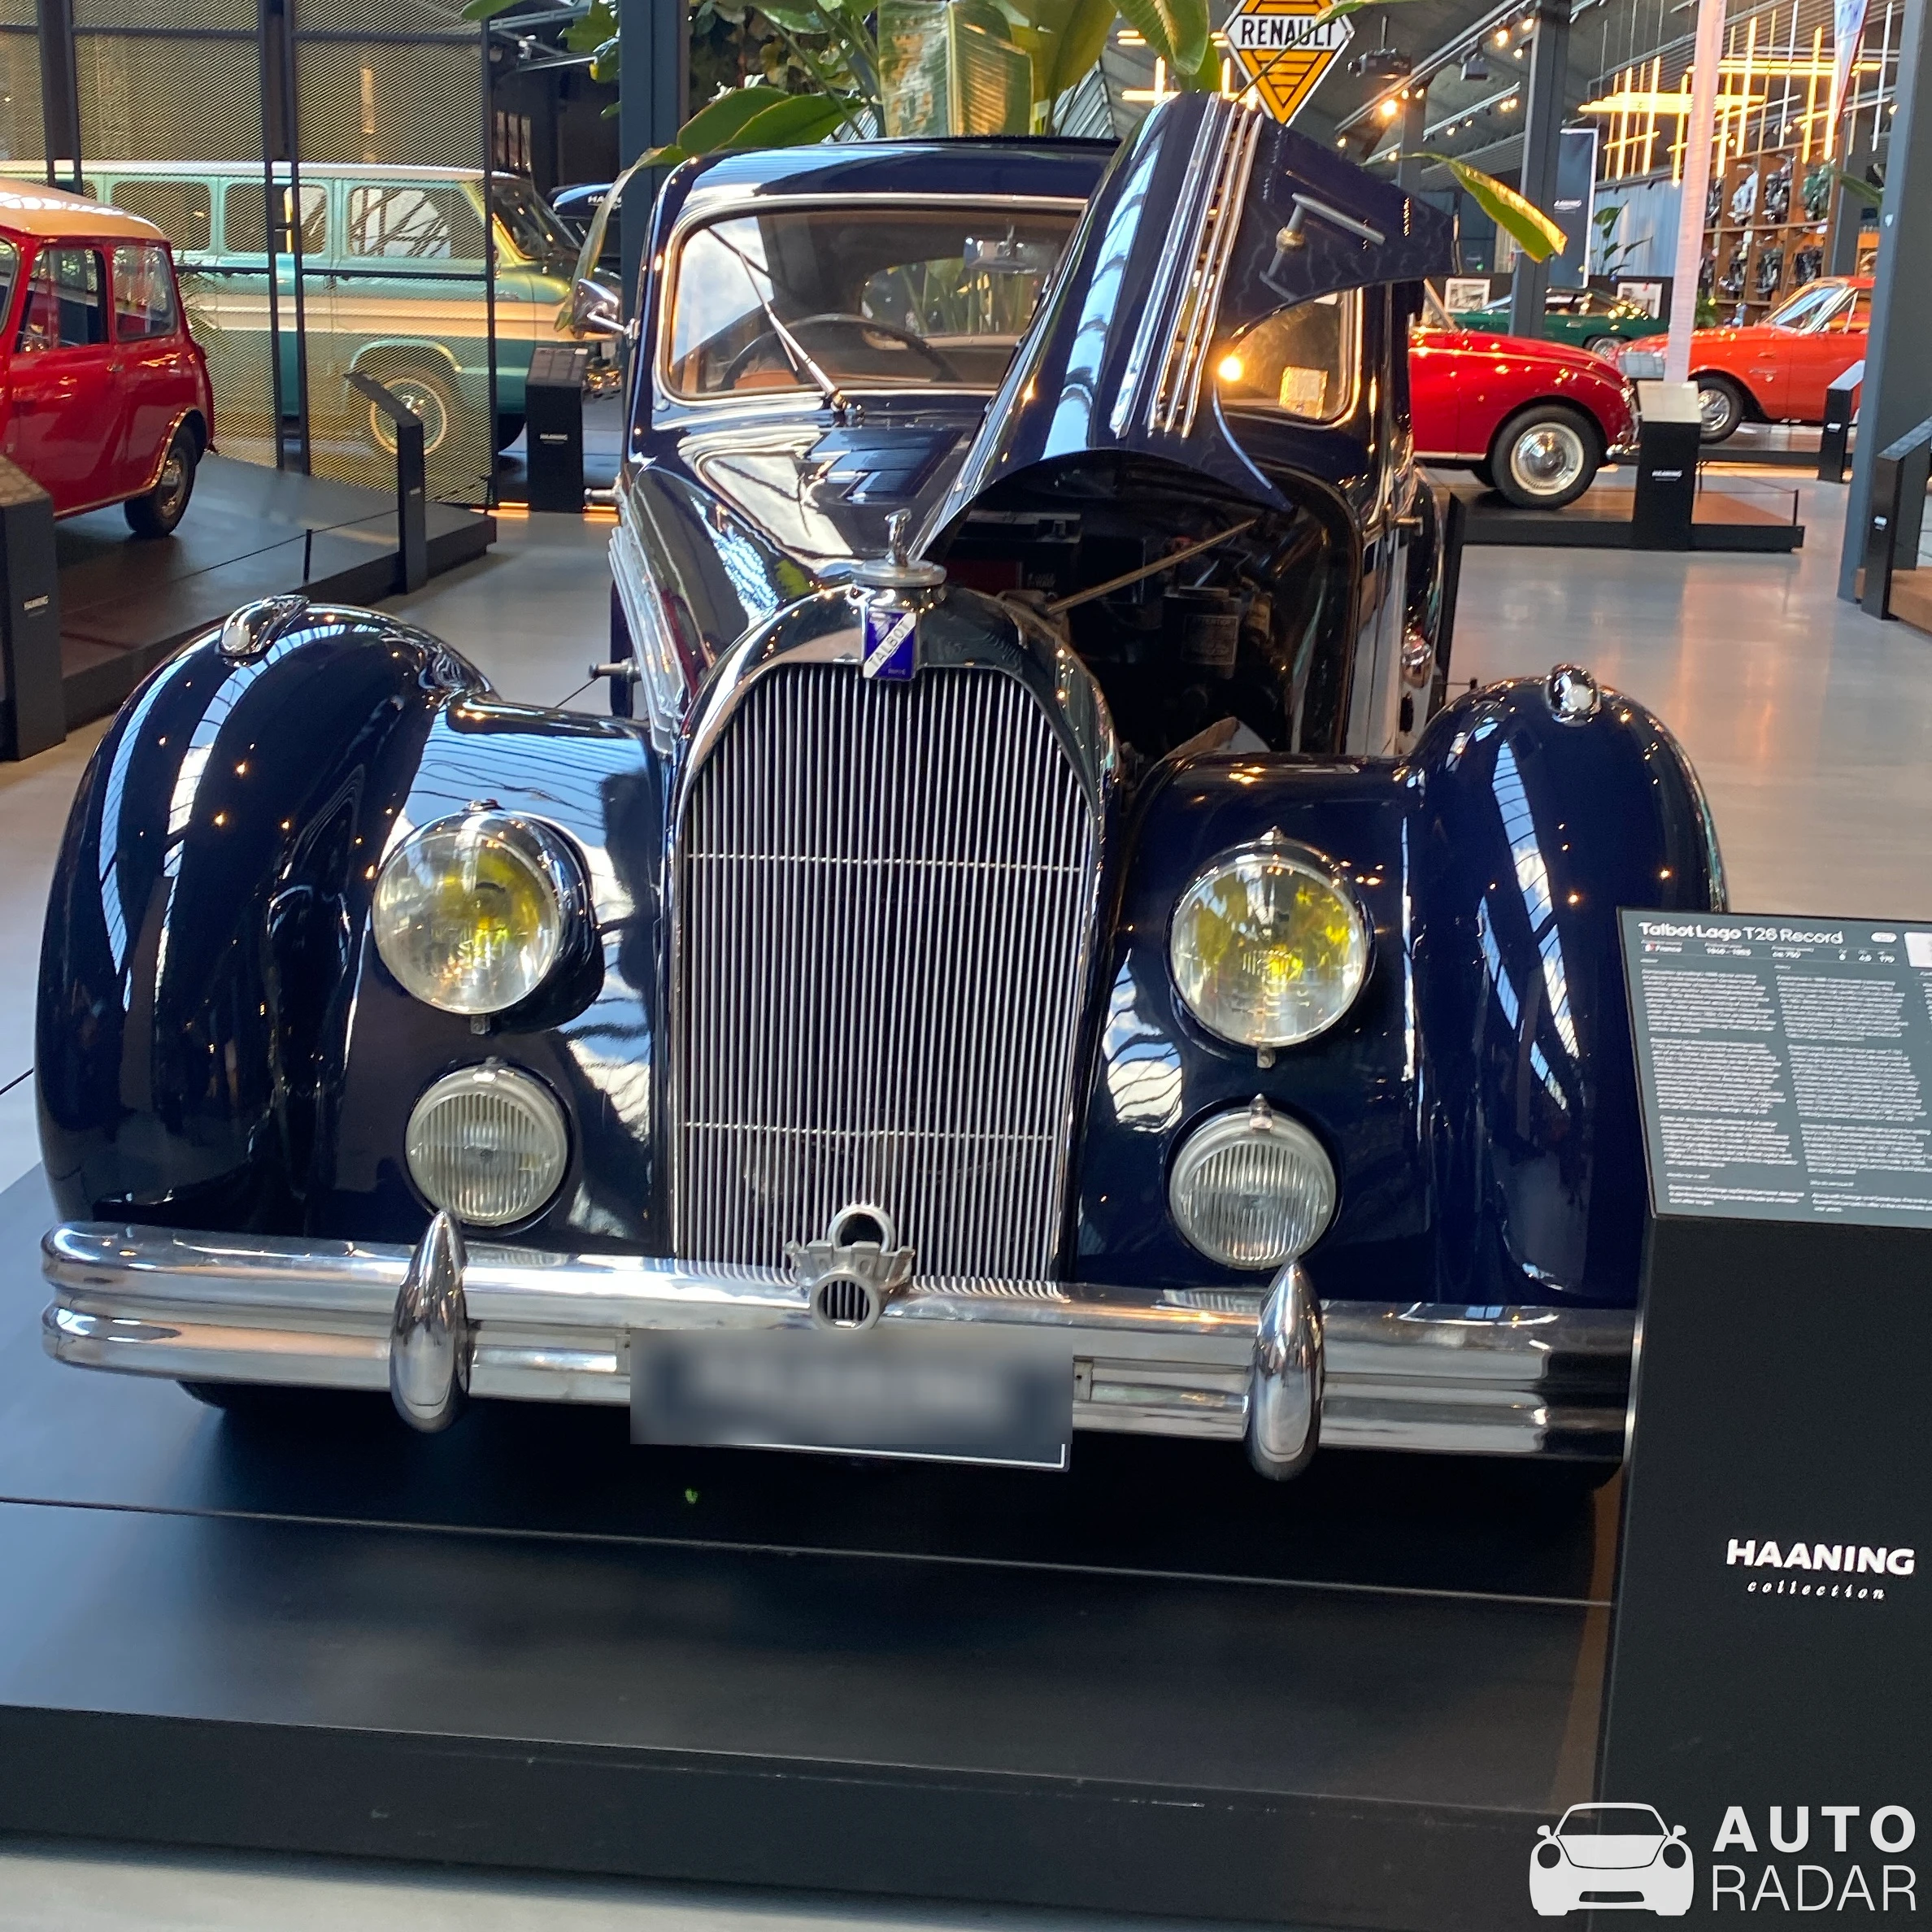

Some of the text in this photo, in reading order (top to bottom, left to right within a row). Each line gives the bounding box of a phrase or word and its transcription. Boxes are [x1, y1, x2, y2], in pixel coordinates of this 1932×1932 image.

[1241, 19, 1337, 47] RENAULT
[1638, 921, 1695, 938] Talbot
[1695, 924, 1742, 942] Lago
[1779, 928, 1844, 945] Record
[1725, 1538, 1916, 1576] HAANING
[1747, 1580, 1886, 1600] collection
